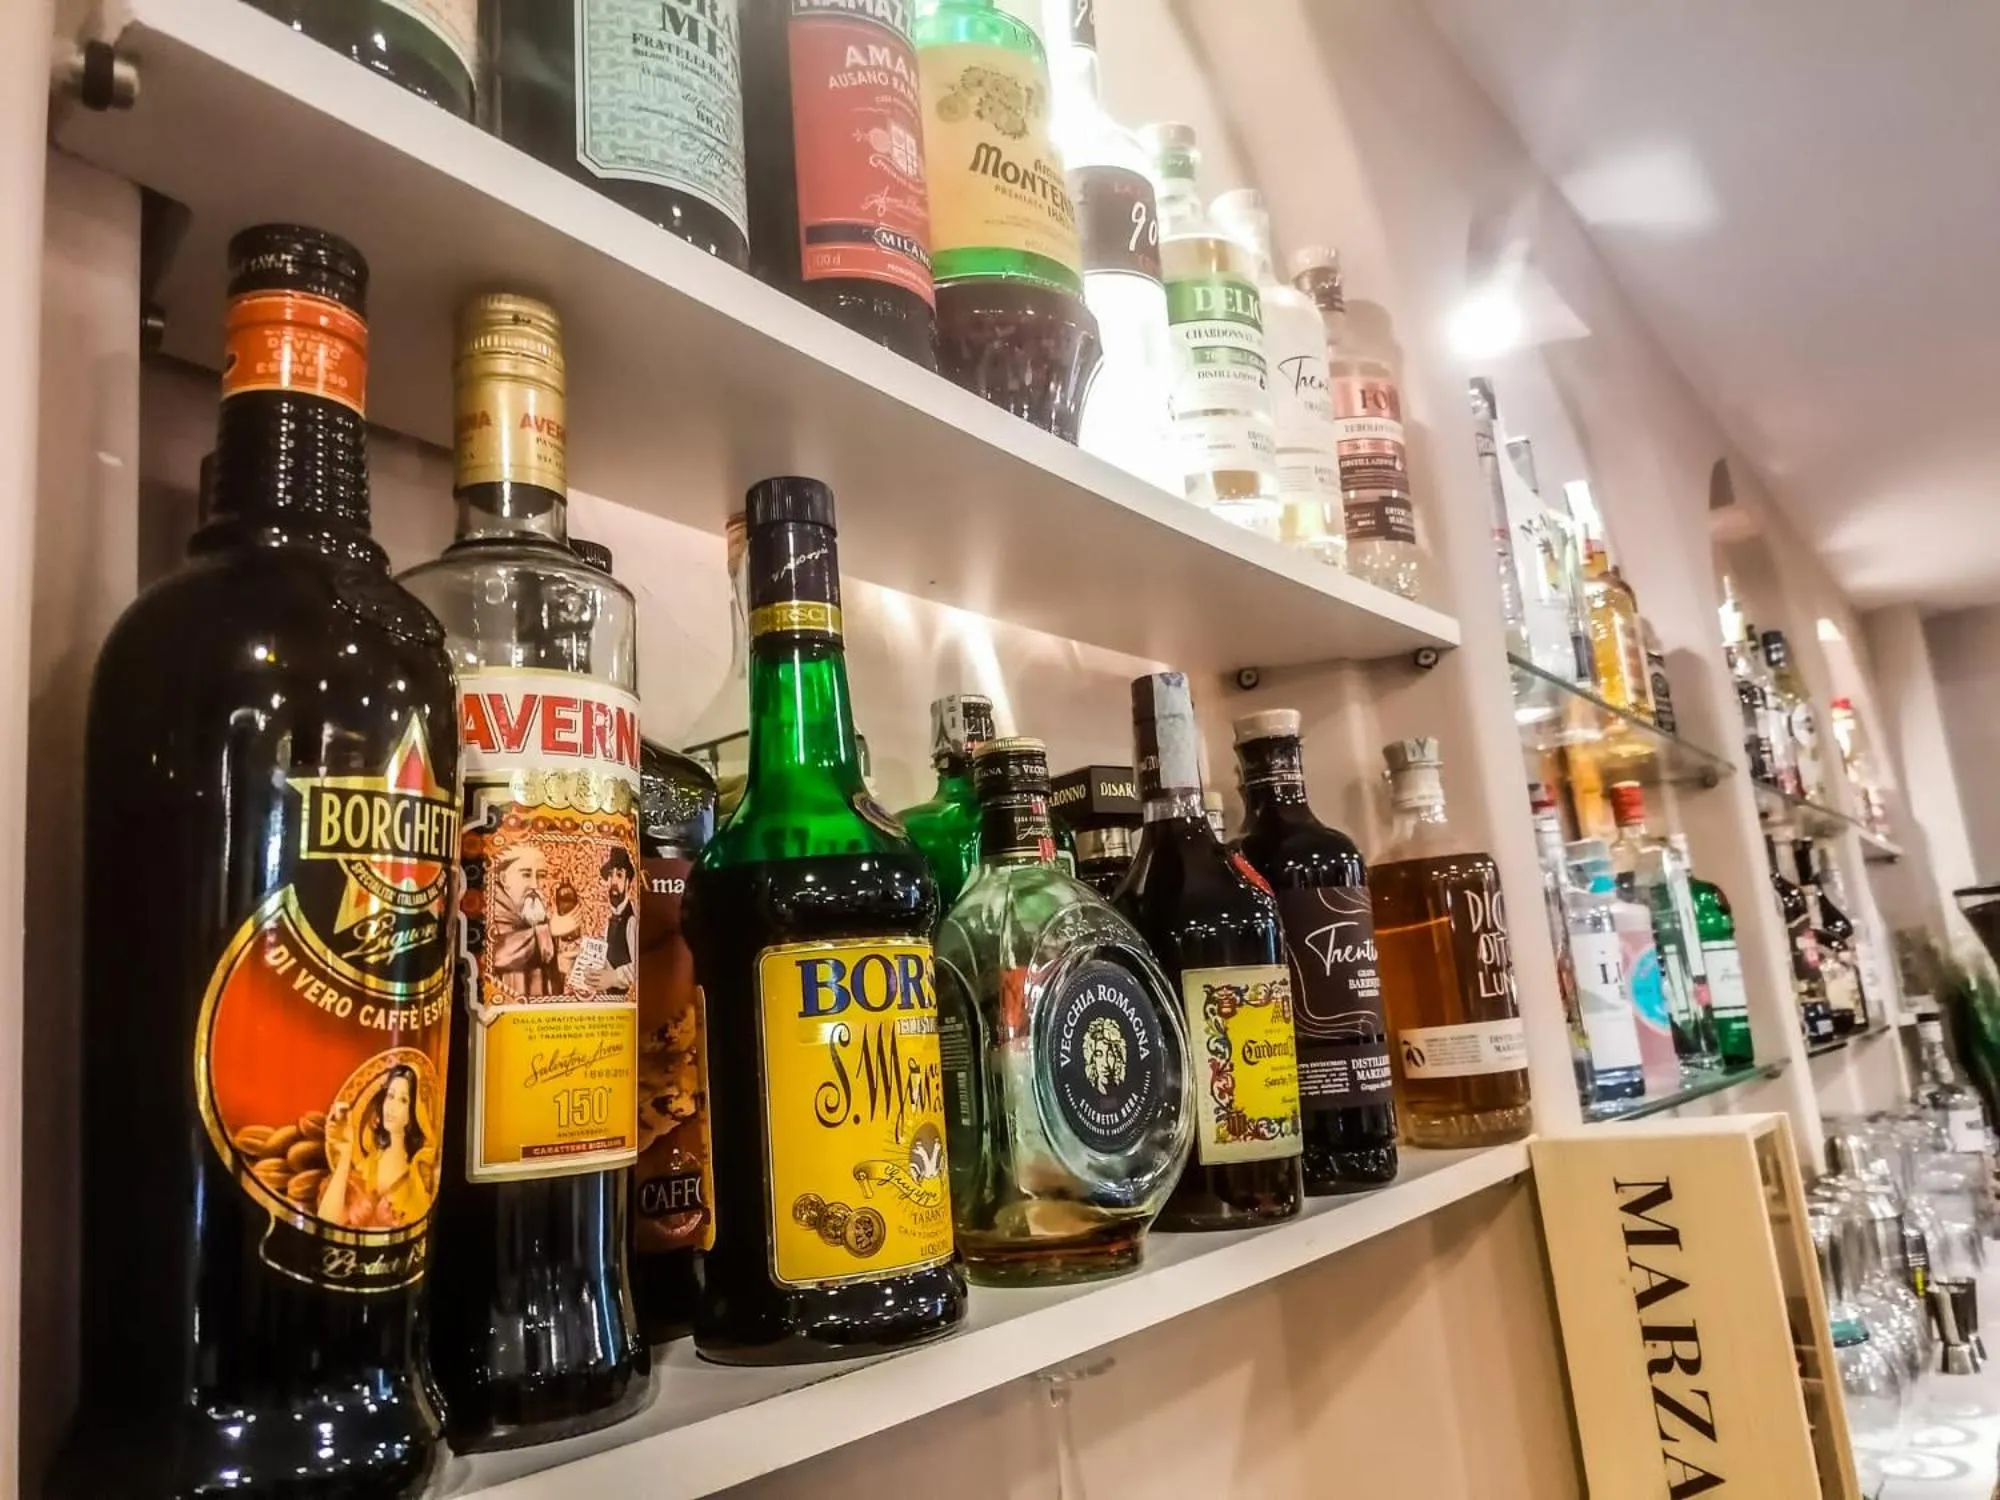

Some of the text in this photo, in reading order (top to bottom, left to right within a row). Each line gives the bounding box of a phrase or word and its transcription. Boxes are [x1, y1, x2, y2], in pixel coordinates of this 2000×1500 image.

[828, 70, 889, 91] AUSANO
[265, 944, 297, 976] DI
[292, 968, 353, 1018] VERO
[359, 1004, 420, 1031] CAFFÈ
[1060, 989, 1096, 1068] VECCHIA
[1097, 984, 1151, 1060] ROMAGNA
[1120, 1092, 1140, 1119] NERA
